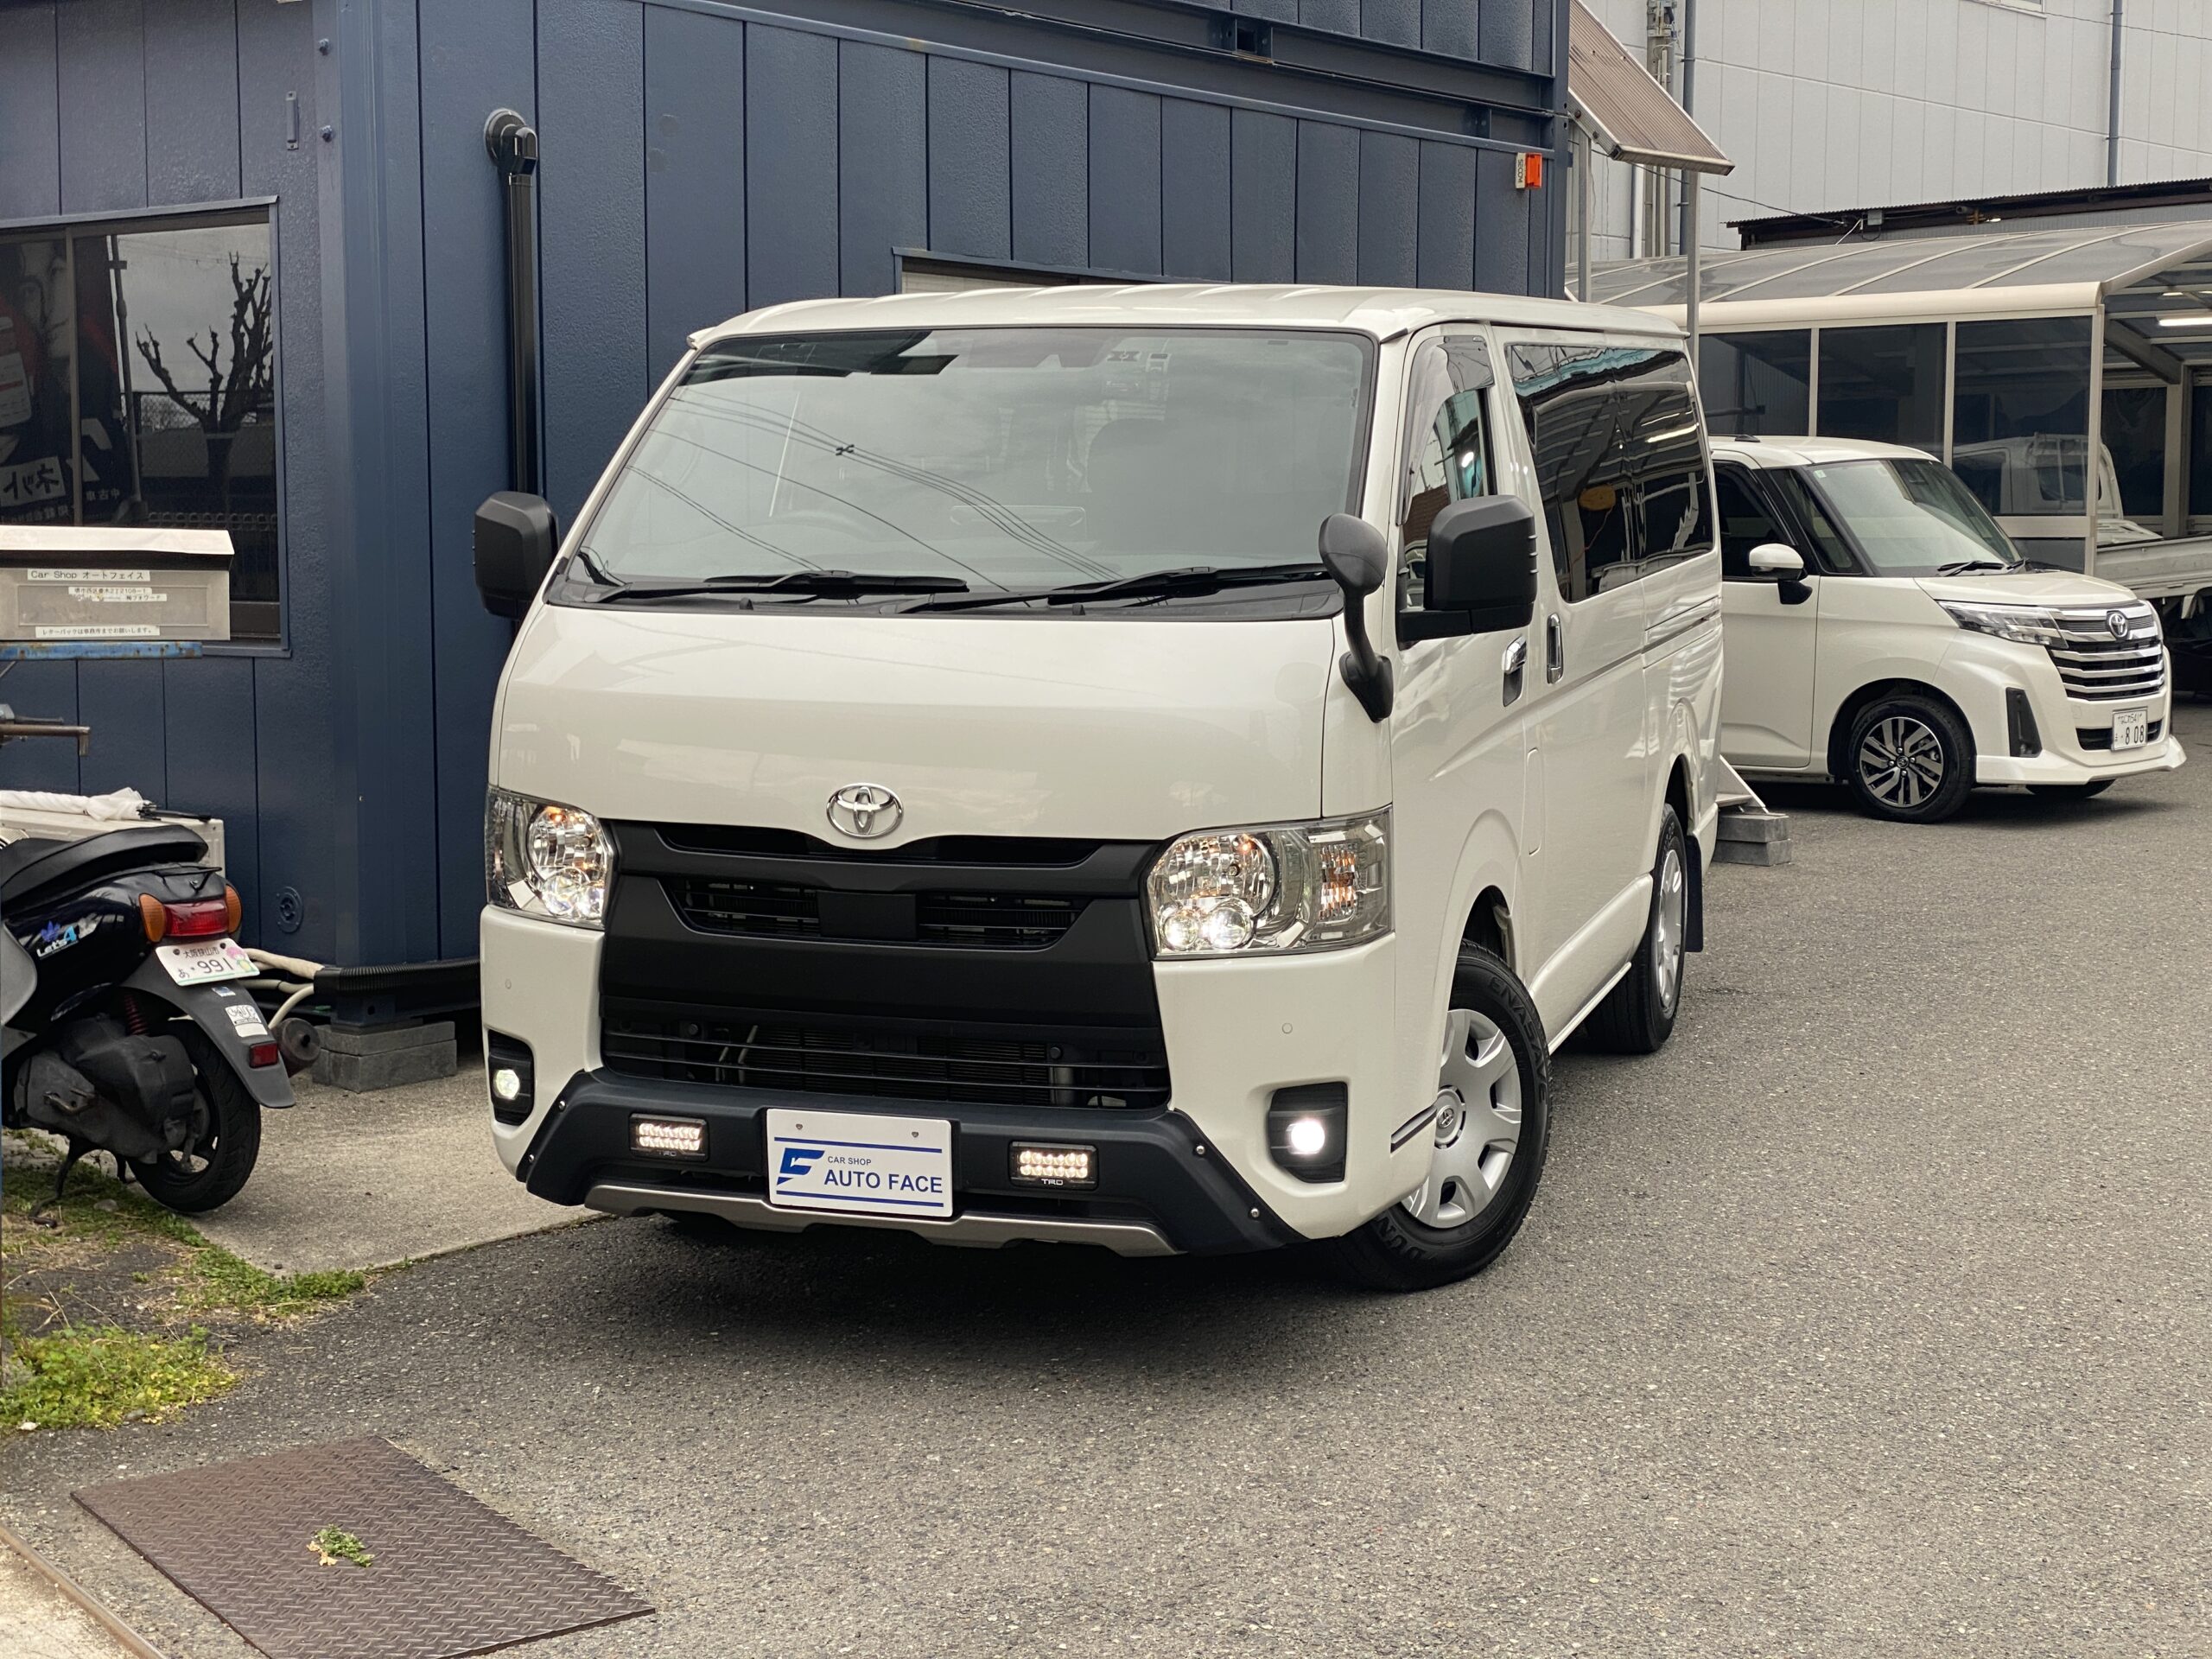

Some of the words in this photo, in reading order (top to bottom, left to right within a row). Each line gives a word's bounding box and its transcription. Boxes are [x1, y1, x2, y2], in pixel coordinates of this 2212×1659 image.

[30, 570, 49, 579] Car
[54, 570, 77, 580] Shop
[82, 571, 143, 580] オートフェイス
[827, 1155, 846, 1165] CAR
[848, 1157, 872, 1166] SHOP
[823, 1169, 880, 1189] AUTO
[888, 1173, 944, 1193] FACE
